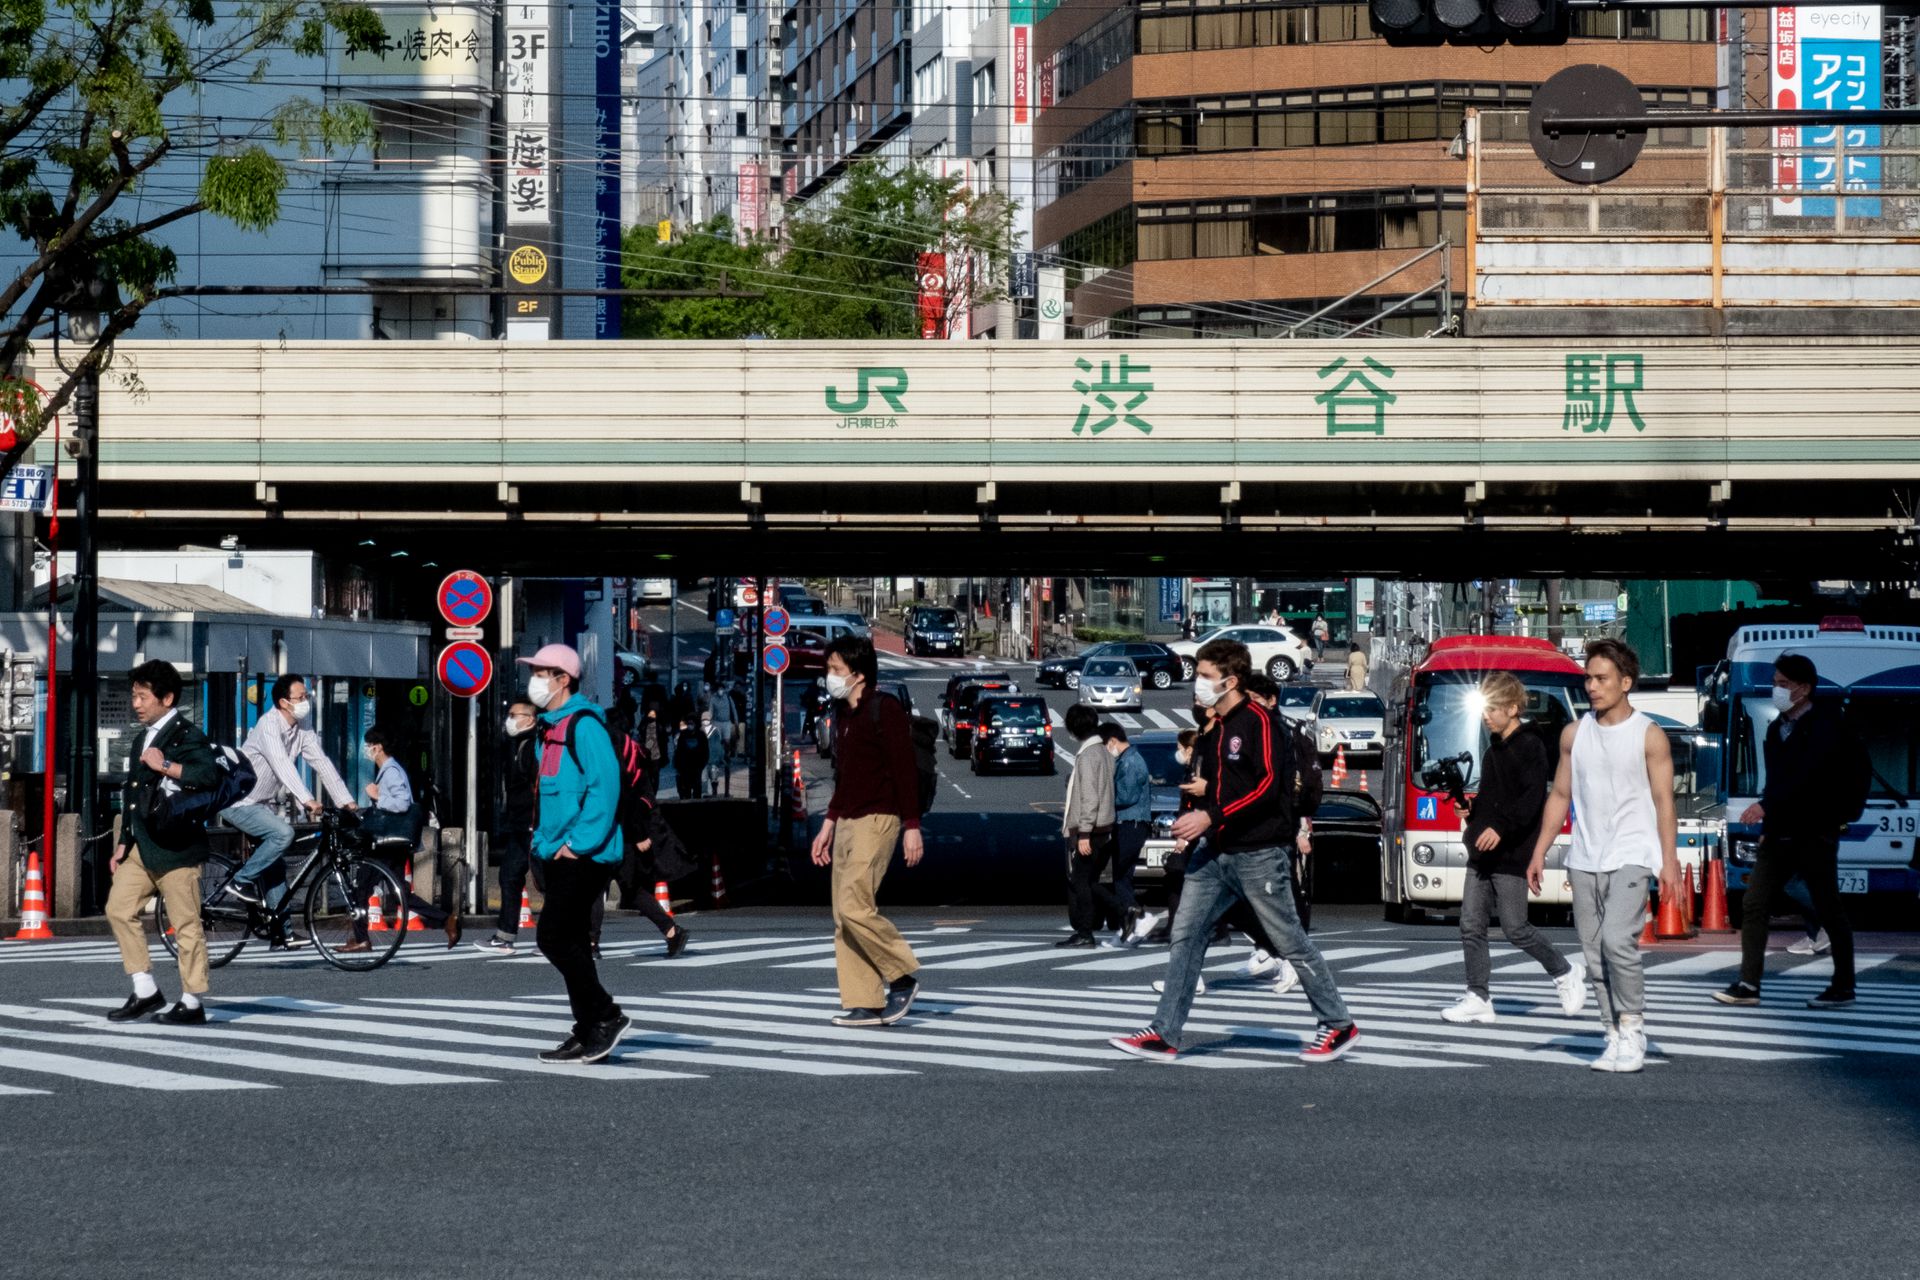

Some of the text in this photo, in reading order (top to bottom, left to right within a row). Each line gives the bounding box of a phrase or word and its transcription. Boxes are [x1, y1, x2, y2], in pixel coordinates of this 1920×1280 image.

[1810, 11, 1870, 30] eyecity
[1778, 7, 1794, 65] 益坂店
[511, 34, 545, 60] 3F
[1846, 55, 1867, 190] コンクトの
[513, 255, 546, 266] Public
[513, 265, 542, 275] Stand
[517, 301, 539, 313] 2F
[825, 367, 909, 413] JR
[1072, 354, 1647, 437] 渋谷駅
[836, 417, 899, 429] JR東日本
[1879, 816, 1915, 833] 3.19
